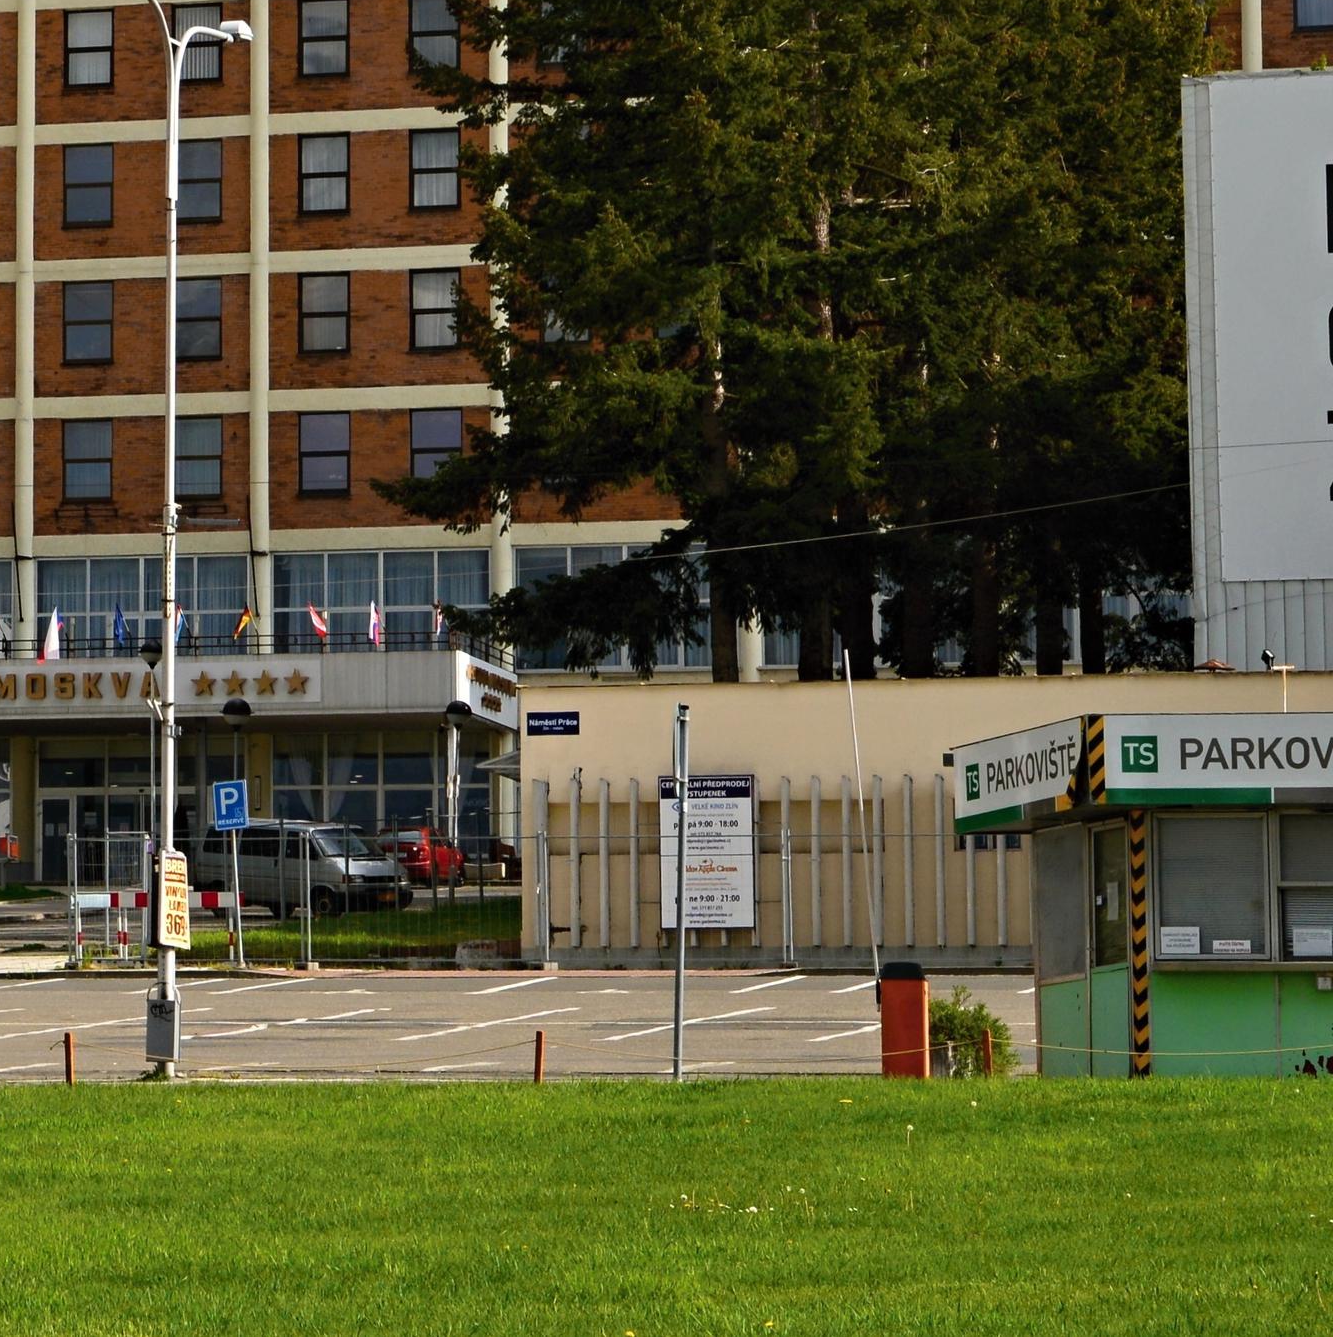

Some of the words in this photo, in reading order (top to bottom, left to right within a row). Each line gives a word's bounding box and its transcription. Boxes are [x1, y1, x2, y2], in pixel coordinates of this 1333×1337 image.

[528, 718, 557, 727] Náměstí
[558, 718, 578, 726] Práce
[1123, 742, 1155, 766] TS
[1179, 736, 1333, 770] PARKOV
[966, 769, 980, 794] TS
[986, 735, 1077, 795] PARKOVIŠTĚ
[661, 779, 702, 789] CENLNÍ
[702, 779, 750, 789] PŘEDPRODEJ
[686, 790, 727, 798] STUPENEK
[219, 788, 238, 815] P
[697, 819, 714, 828] 9:00
[719, 819, 739, 828] 18:00
[699, 894, 715, 903] 9:00
[720, 894, 741, 903] 21:00
